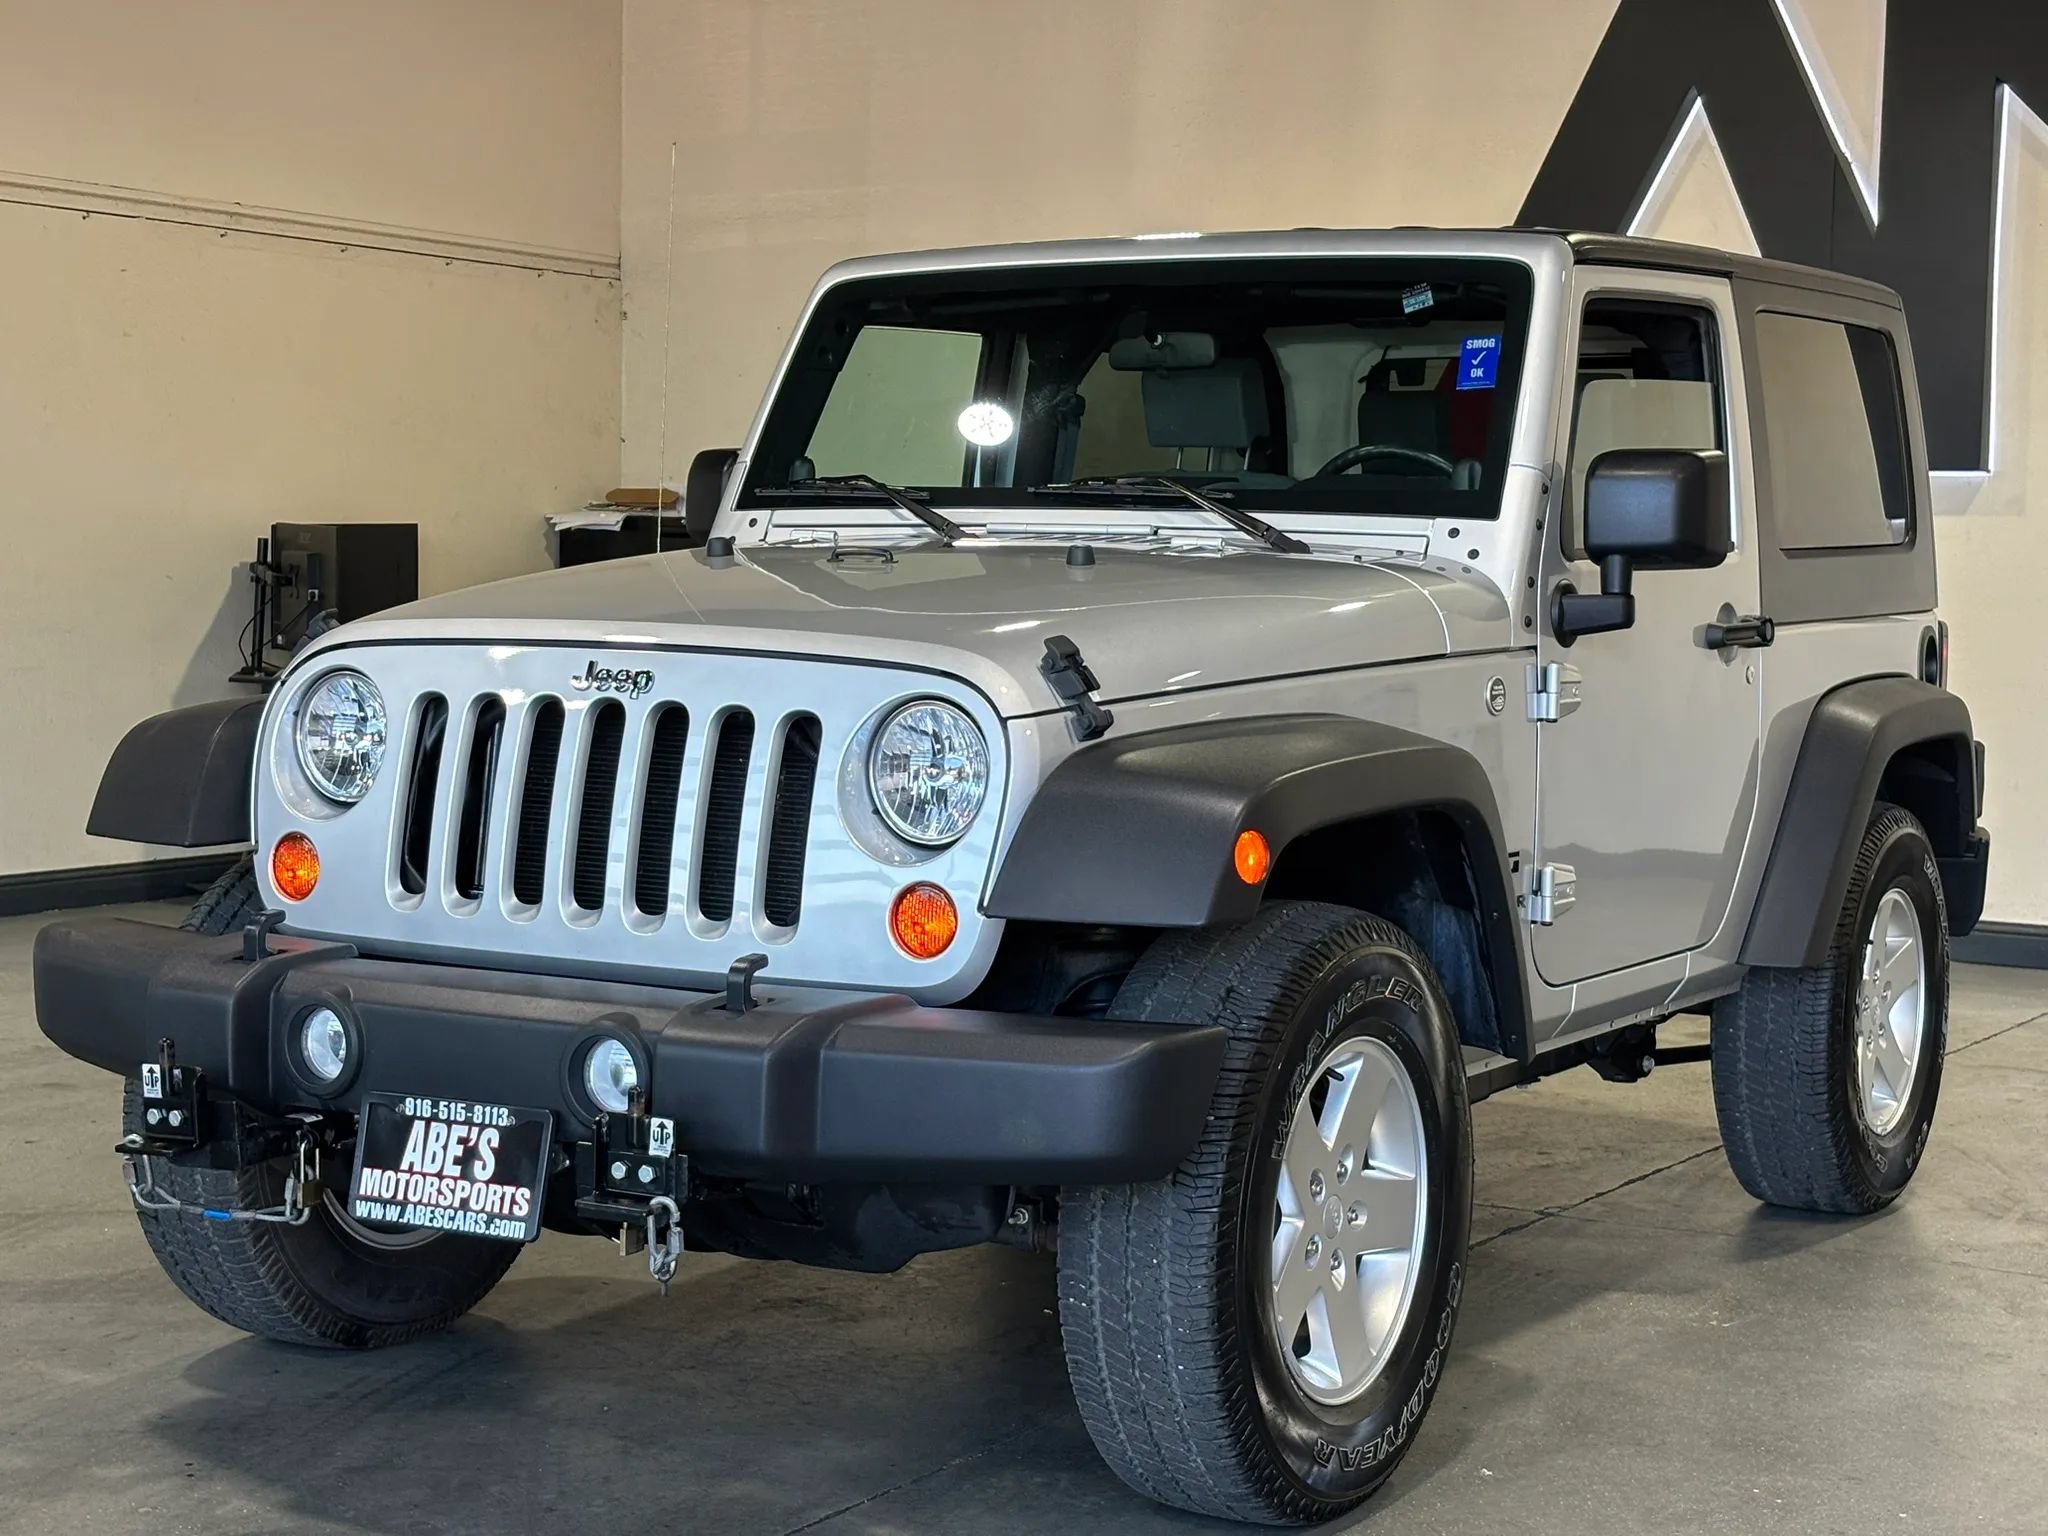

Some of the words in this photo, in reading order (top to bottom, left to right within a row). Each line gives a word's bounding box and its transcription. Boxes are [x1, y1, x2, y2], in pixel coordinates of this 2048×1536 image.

[1466, 338, 1496, 350] SMOG
[1470, 367, 1485, 378] OK
[569, 659, 656, 700] Jeep
[144, 1074, 160, 1088] UP
[1271, 974, 1425, 1160] WRANGLER
[404, 1097, 510, 1127] 916-515-8113
[399, 1119, 500, 1182] ABE'S
[652, 1128, 671, 1145] UP
[359, 1167, 532, 1217] MOTORSPORTS
[1313, 1260, 1462, 1472] GOODYEAR
